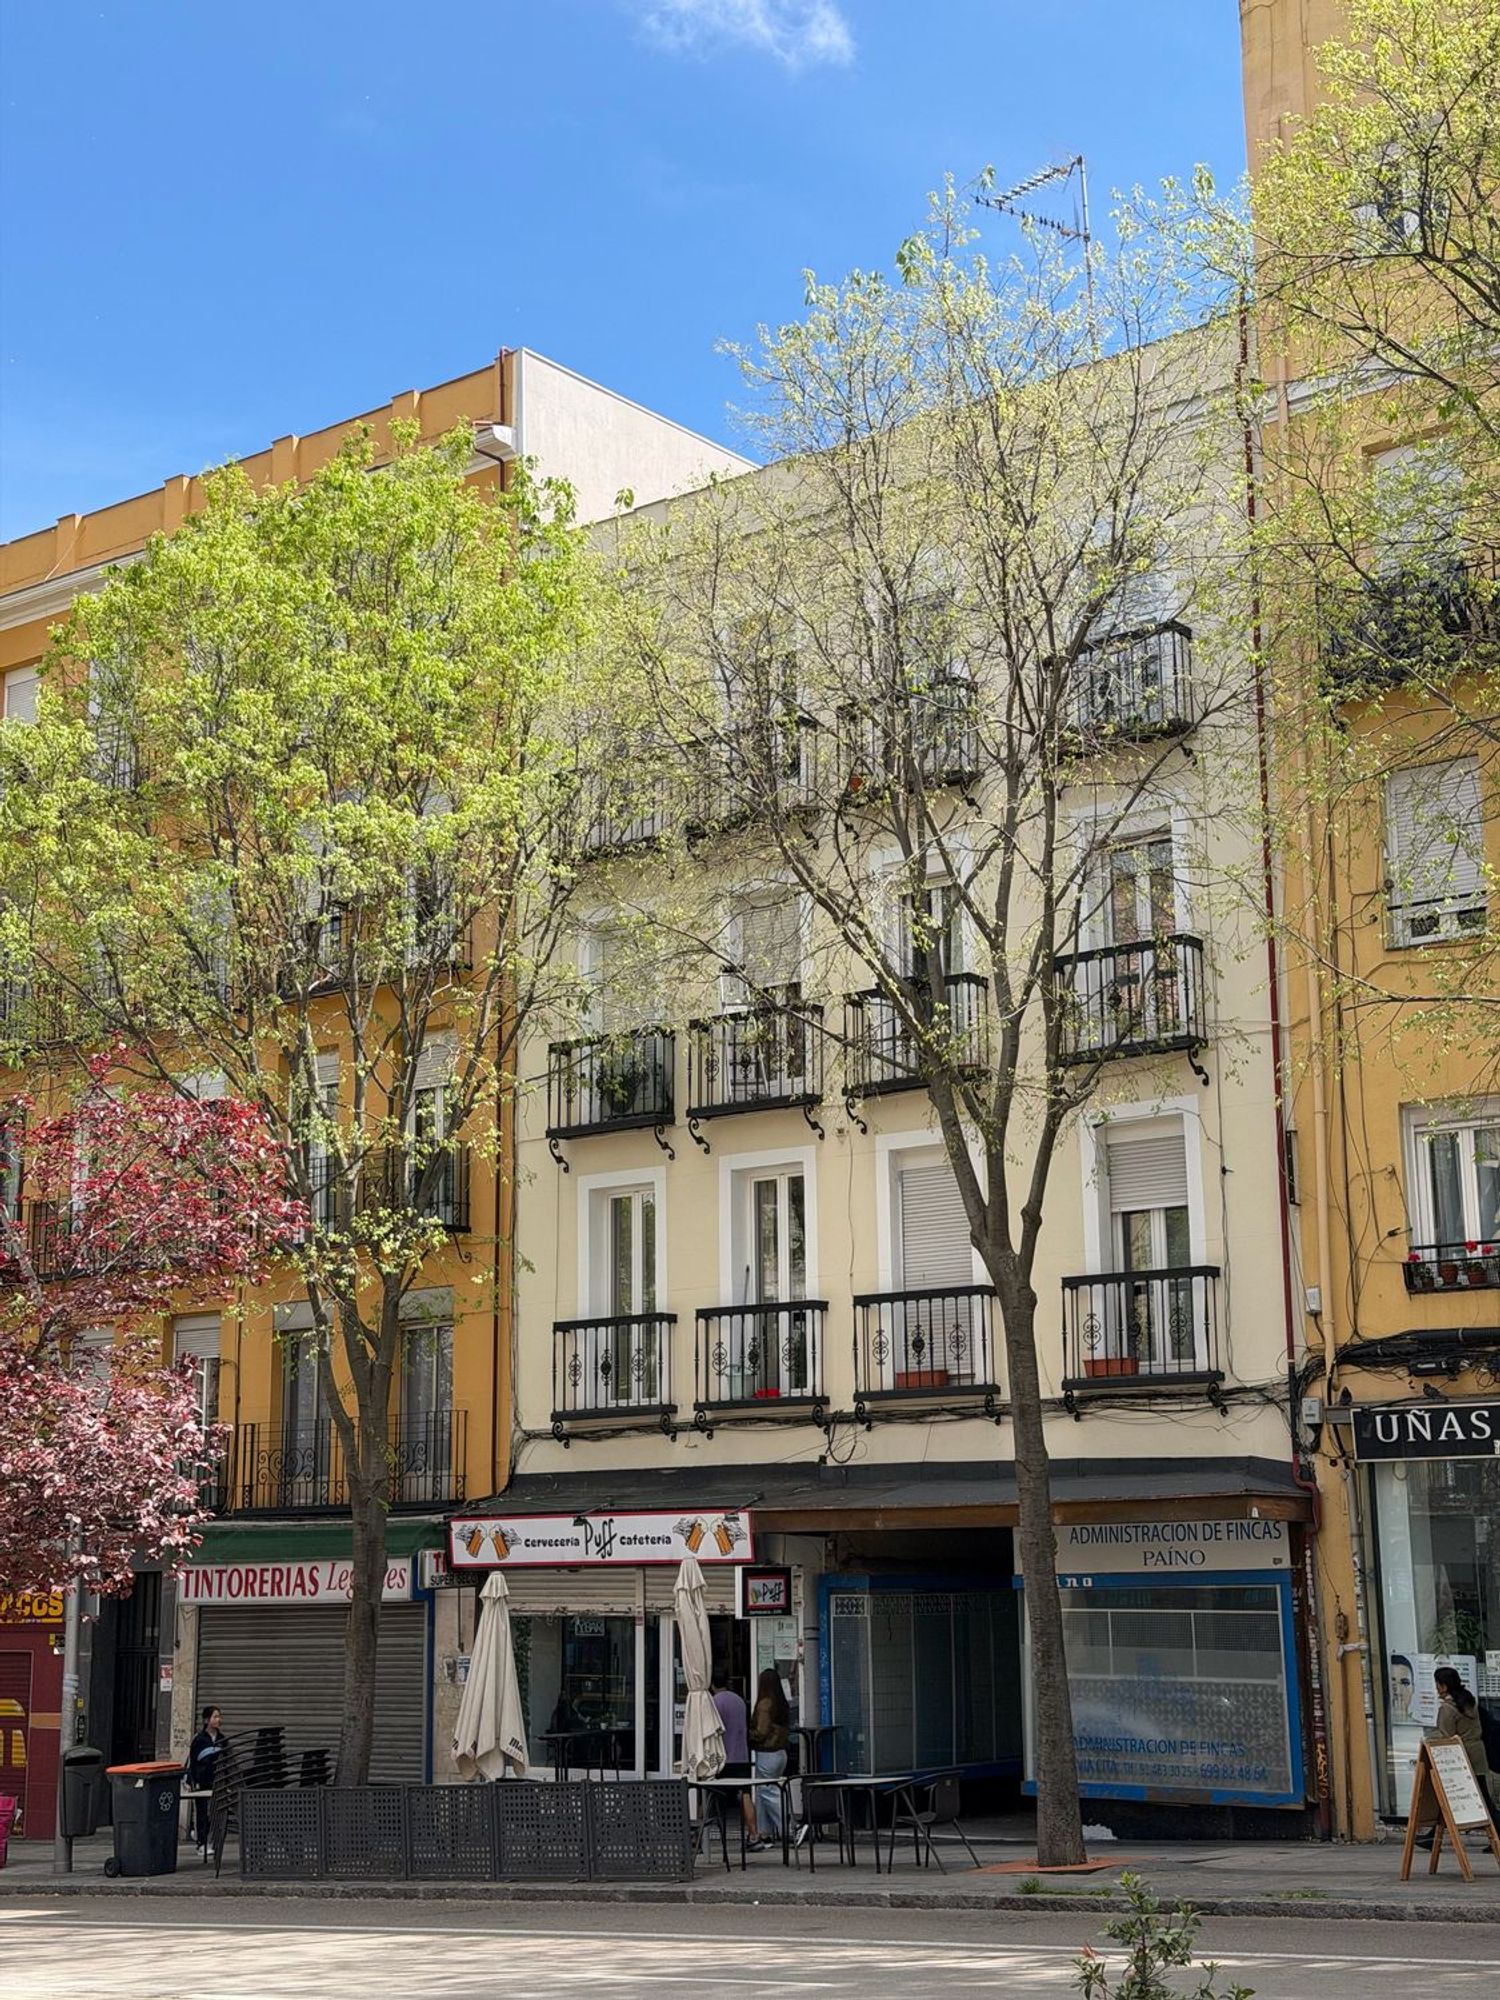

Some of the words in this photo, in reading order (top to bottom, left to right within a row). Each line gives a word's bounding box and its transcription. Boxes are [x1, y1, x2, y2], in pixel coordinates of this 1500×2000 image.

[1375, 1409, 1491, 1443] UÑAS
[583, 1517, 618, 1559] Puff
[1070, 1523, 1198, 1544] ADMINISTRACION
[1202, 1522, 1222, 1542] DE
[1226, 1520, 1282, 1540] FINCAS
[1143, 1546, 1206, 1567] PAÍNO
[182, 1564, 320, 1600] TINTORERIAS
[326, 1562, 407, 1600] Leges
[1055, 1574, 1093, 1588] ina
